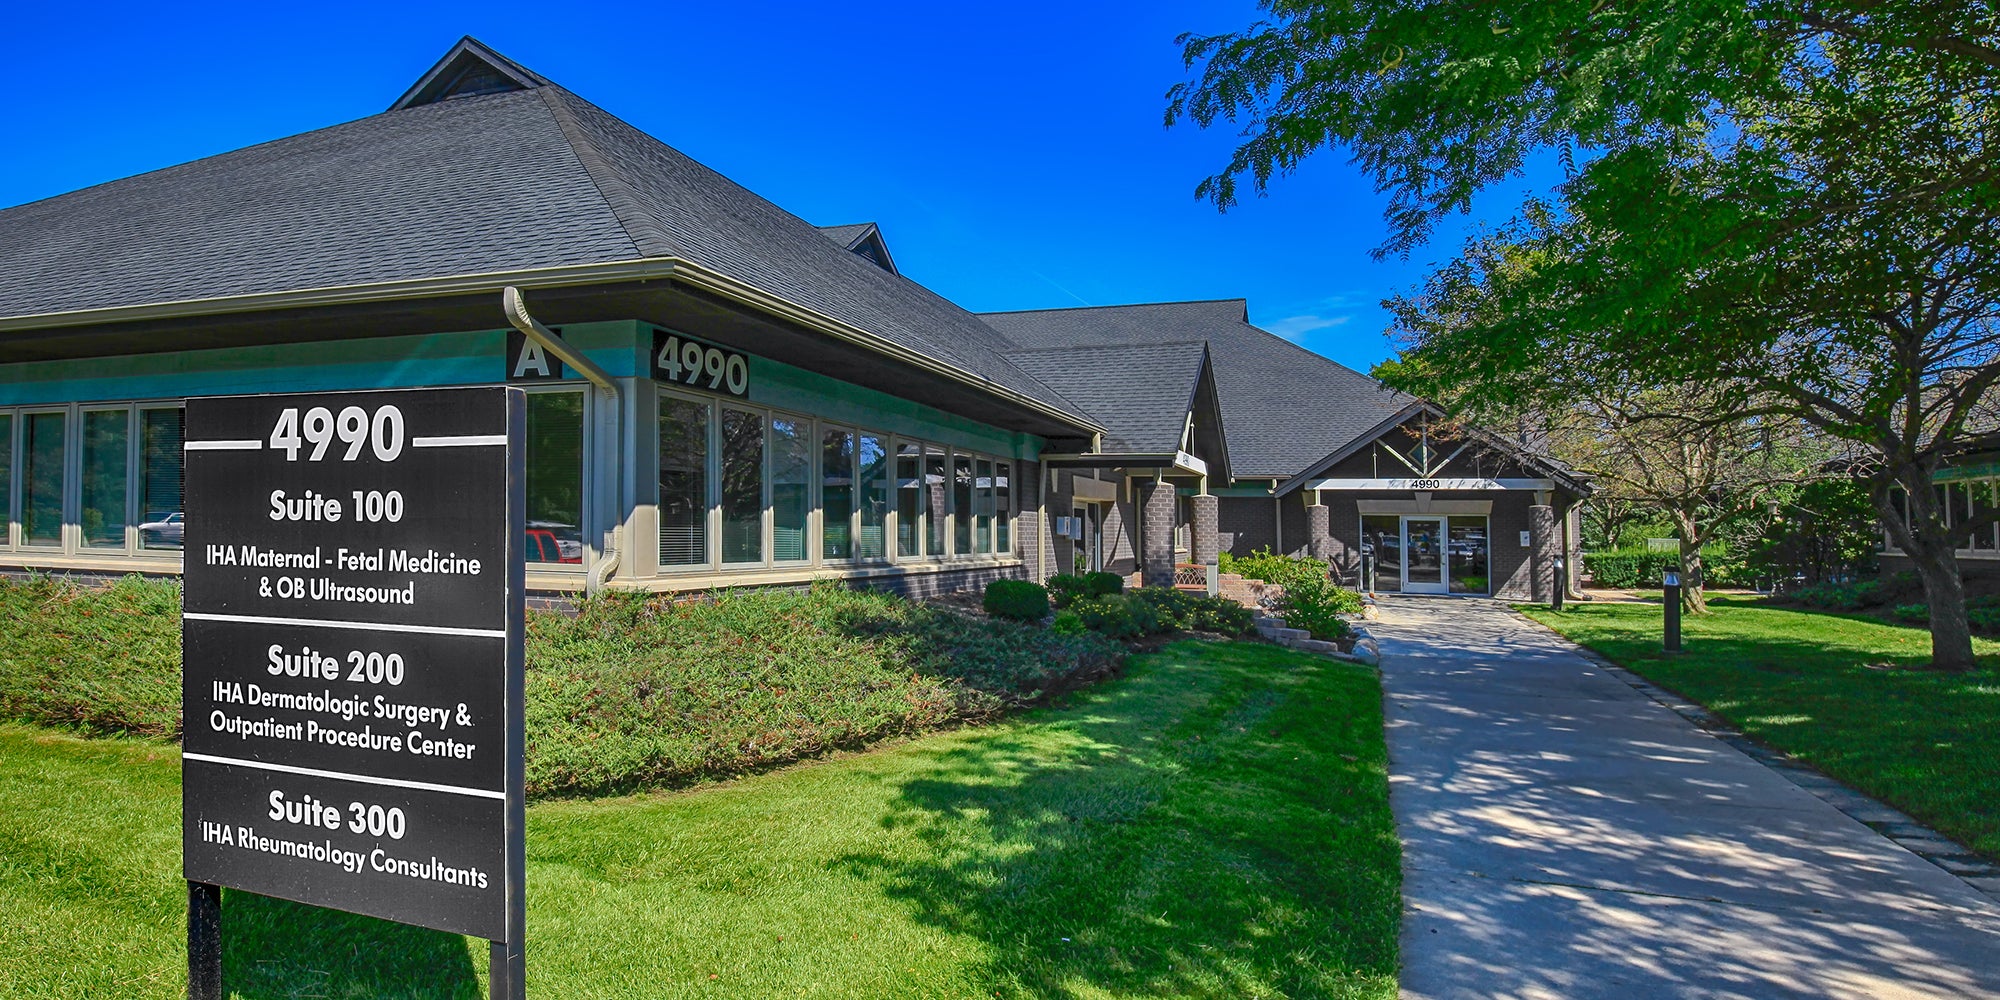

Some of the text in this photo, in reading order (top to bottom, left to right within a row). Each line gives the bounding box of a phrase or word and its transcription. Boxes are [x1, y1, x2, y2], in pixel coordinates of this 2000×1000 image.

[513, 334, 550, 377] A
[657, 335, 748, 395] 4990
[269, 404, 405, 462] 4990
[269, 489, 404, 523] Suite 100
[1411, 479, 1440, 489] 4990
[206, 544, 238, 566] IHA
[240, 545, 321, 569] Maternal
[337, 548, 384, 571] Fetal
[388, 549, 481, 575] Medicine
[258, 576, 415, 605] & OB Ultrasound
[267, 644, 405, 686] Suite 200
[213, 680, 473, 731] IHA Dermatologic Surgery &
[210, 709, 476, 760] Outpatient Procedure Center
[268, 789, 406, 840] Suite 300
[203, 820, 488, 889] IHA Rheumatology Consultants
